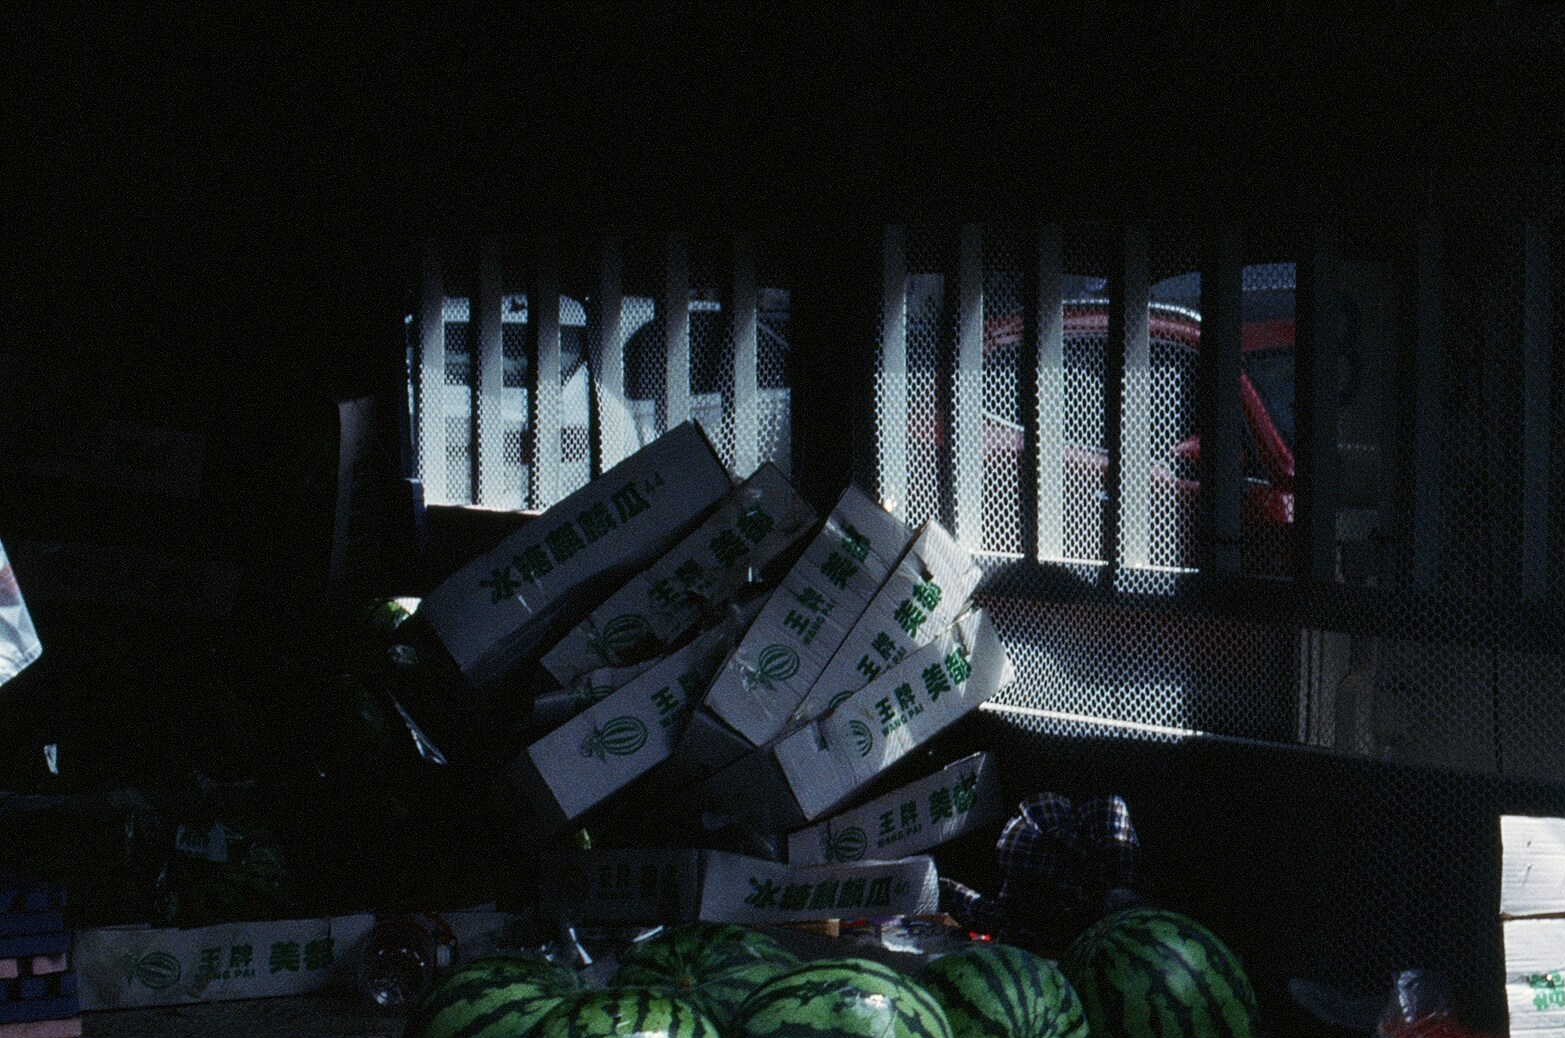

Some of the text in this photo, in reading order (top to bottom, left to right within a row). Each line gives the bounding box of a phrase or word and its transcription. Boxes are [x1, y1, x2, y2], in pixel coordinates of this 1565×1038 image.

[783, 586, 825, 636] 王牌
[856, 581, 942, 683] 王牌 美都
[875, 682, 916, 724] 王牌
[921, 647, 972, 702] 美都
[879, 800, 918, 836] 王牌
[744, 877, 893, 911] 冰糖麒麟瓜
[200, 940, 335, 974] 王牌 美都
